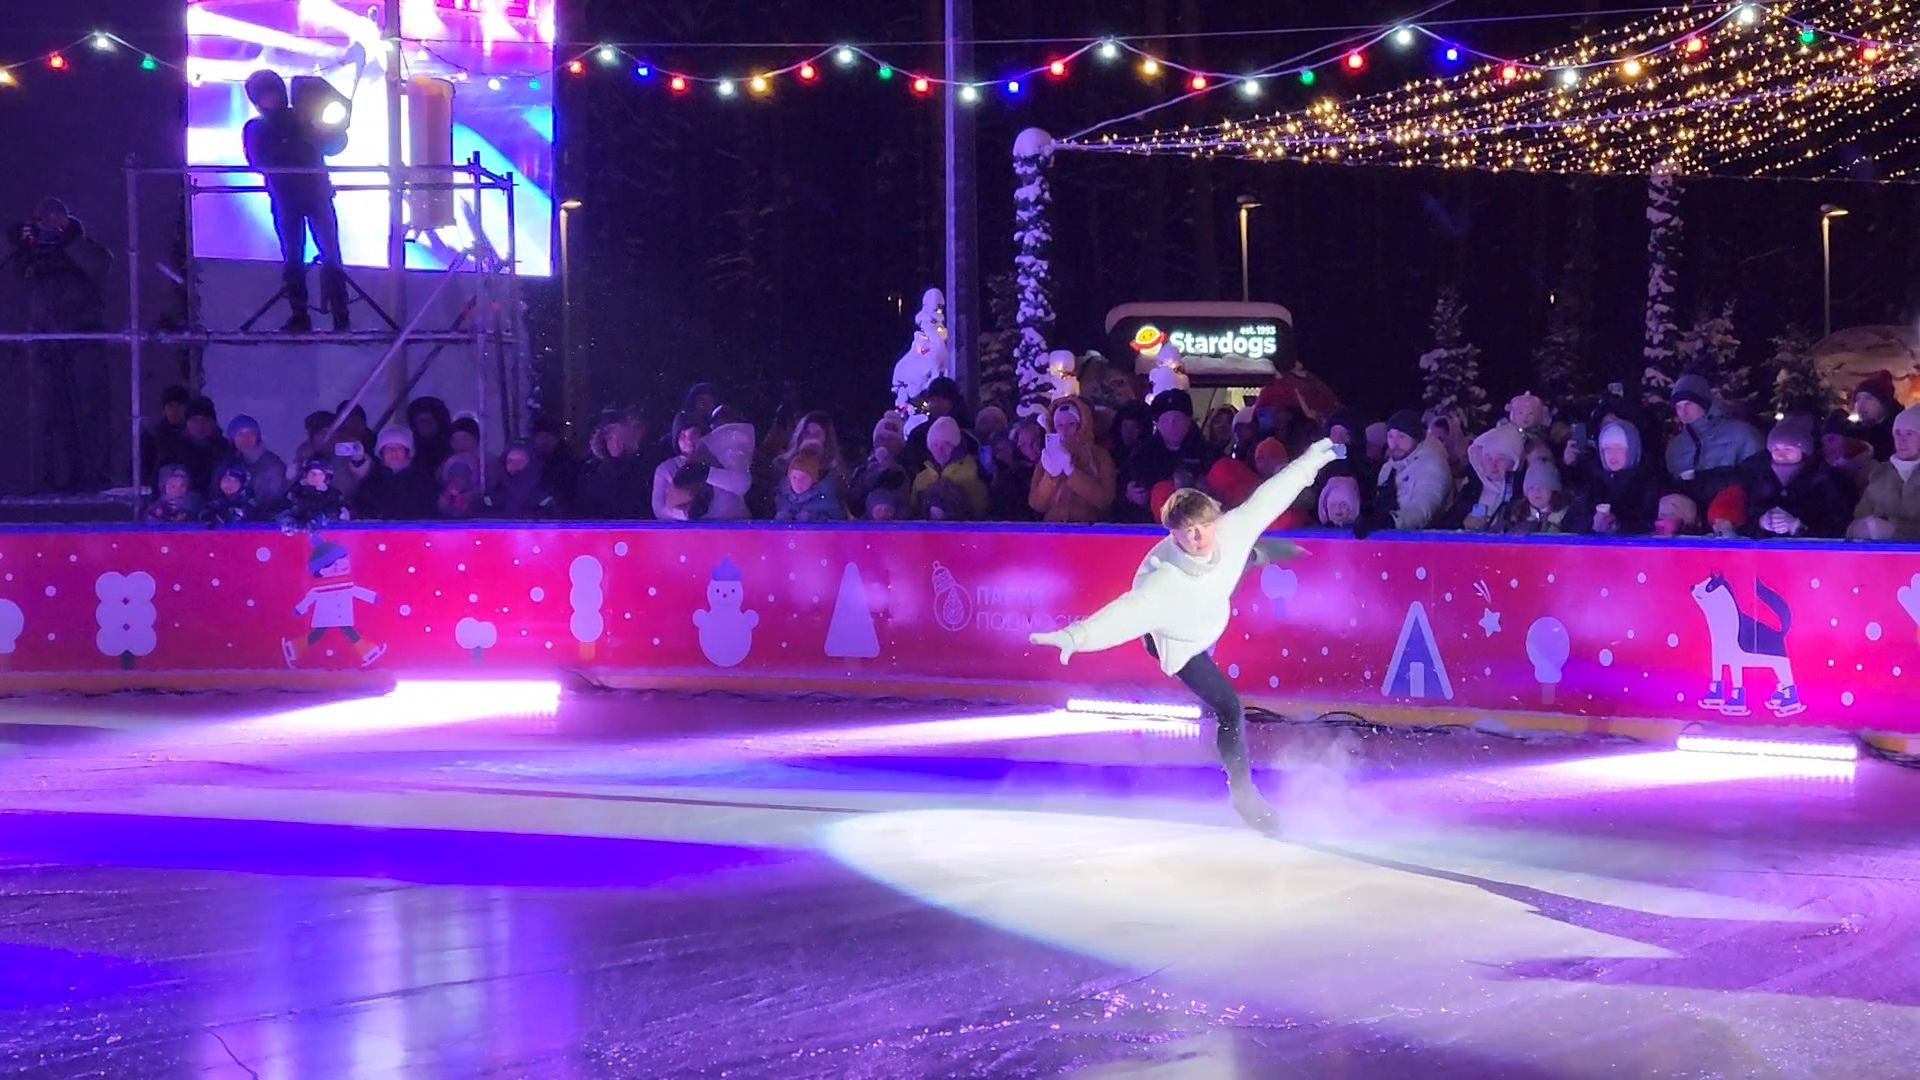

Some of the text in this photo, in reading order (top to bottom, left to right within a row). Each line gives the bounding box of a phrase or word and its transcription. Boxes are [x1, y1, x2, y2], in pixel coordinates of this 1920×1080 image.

[1240, 325, 1276, 335] est. 1993
[1170, 331, 1277, 358] Stardogs
